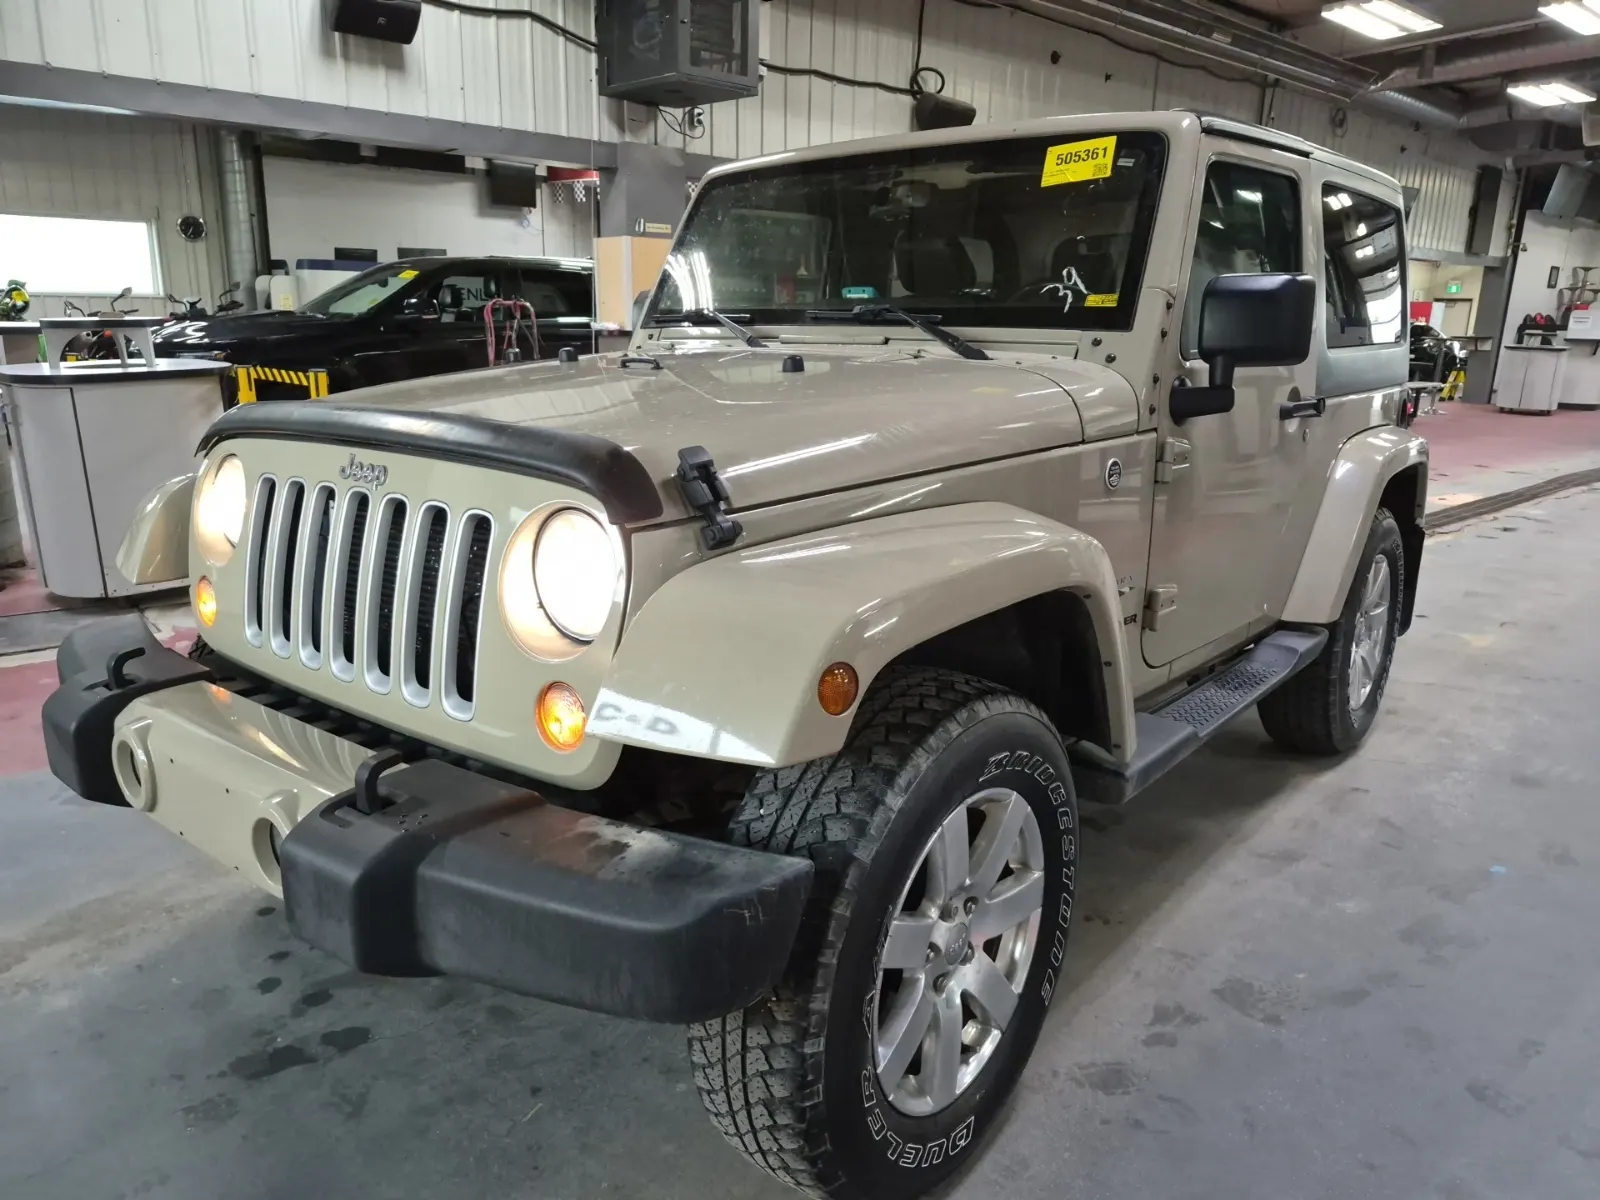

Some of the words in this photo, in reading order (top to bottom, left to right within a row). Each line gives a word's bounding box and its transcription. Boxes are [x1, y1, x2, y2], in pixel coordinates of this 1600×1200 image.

[1055, 146, 1108, 167] 505361
[339, 453, 388, 491] Jeep
[979, 751, 1075, 1006] BRIDGESTONE
[861, 1066, 975, 1168] DUELER
